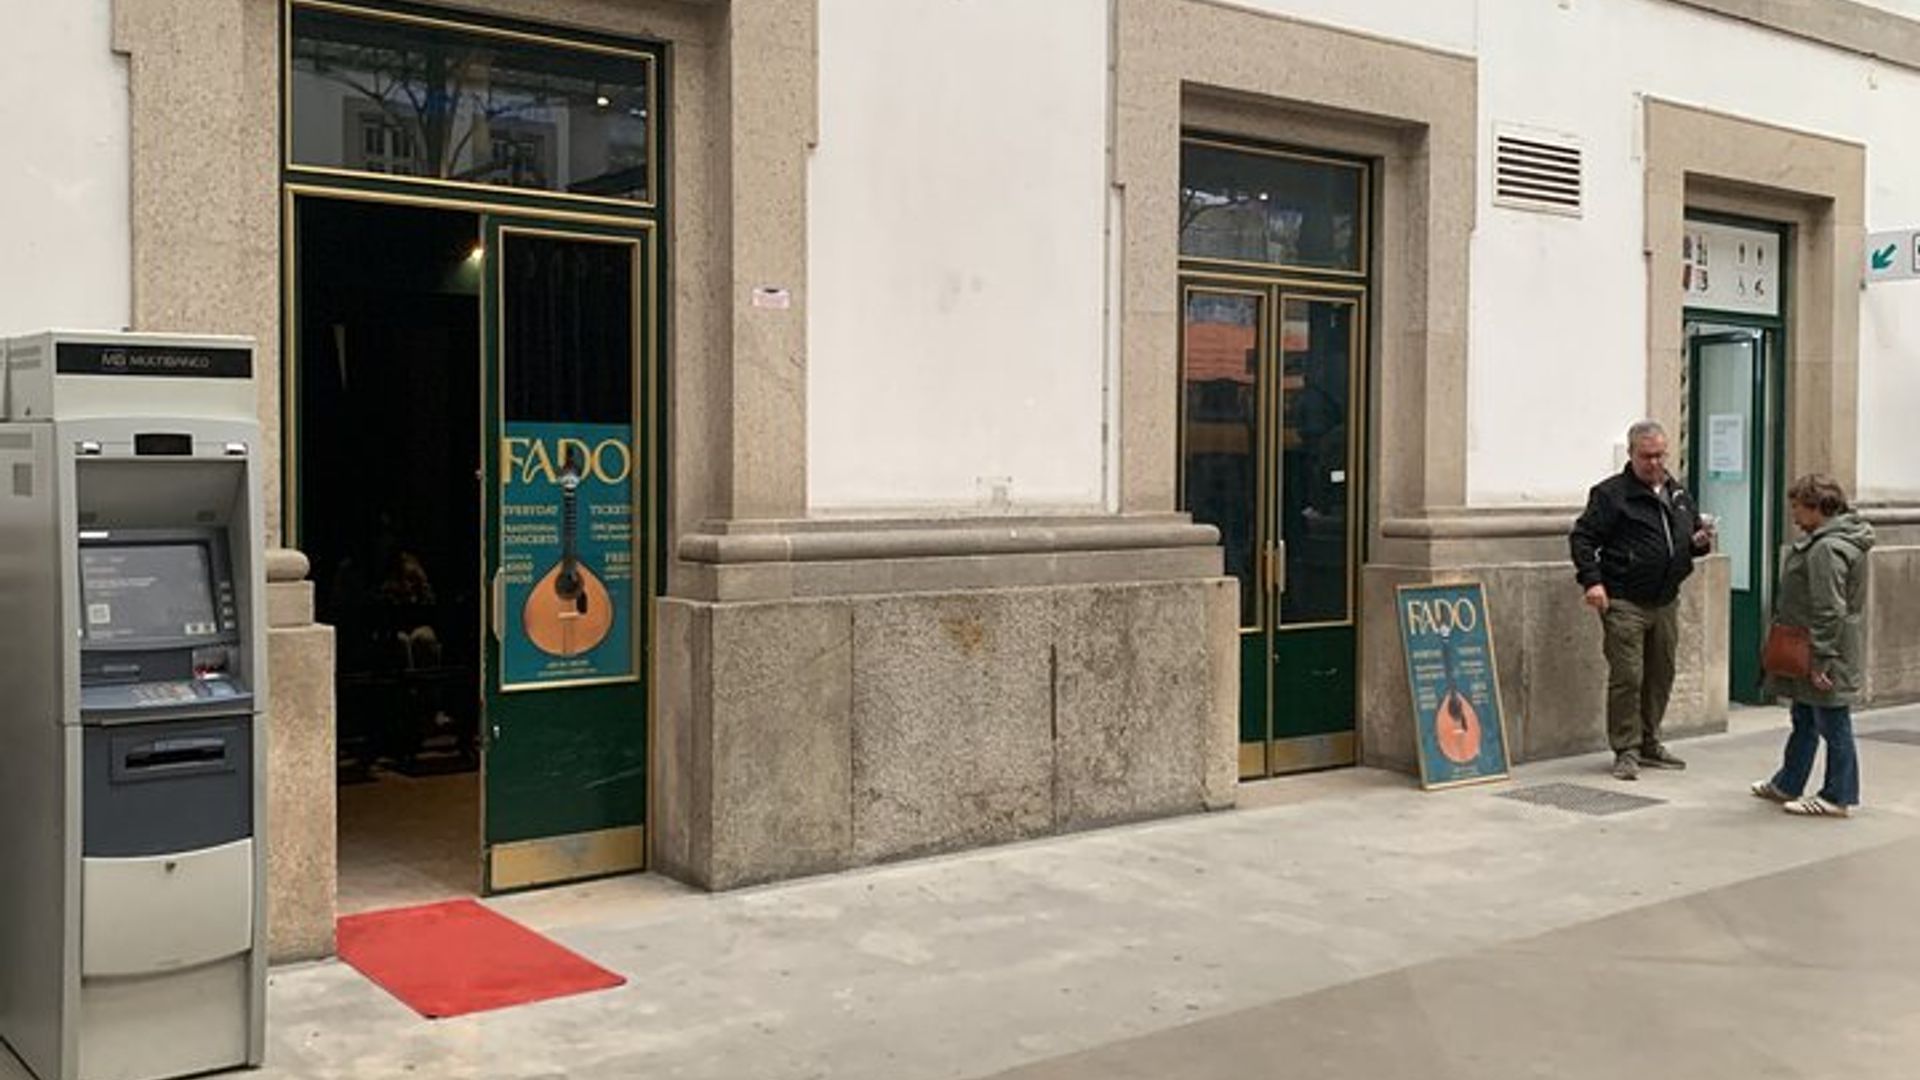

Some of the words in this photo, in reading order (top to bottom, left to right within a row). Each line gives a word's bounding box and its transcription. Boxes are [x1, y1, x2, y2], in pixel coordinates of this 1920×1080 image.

[129, 355, 211, 368] MULTIBANCO
[501, 438, 631, 484] FADO
[1408, 598, 1476, 635] FADO
